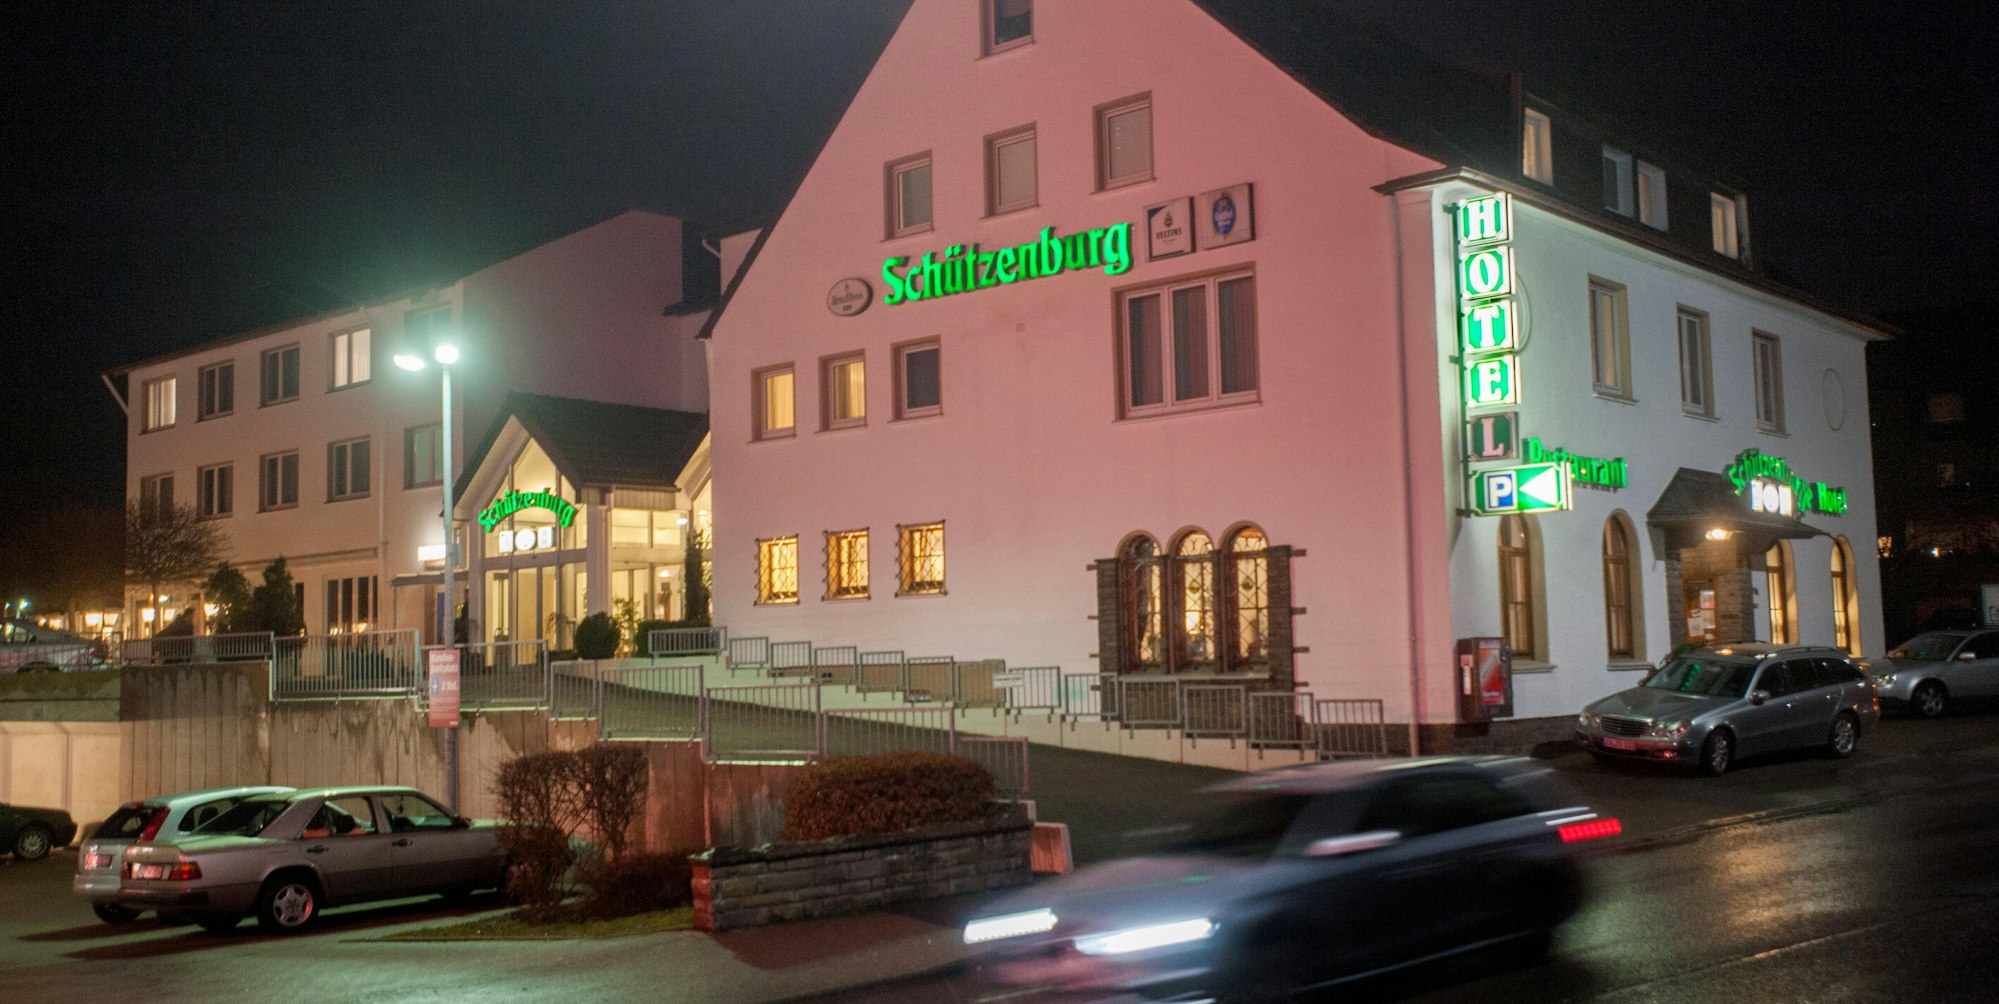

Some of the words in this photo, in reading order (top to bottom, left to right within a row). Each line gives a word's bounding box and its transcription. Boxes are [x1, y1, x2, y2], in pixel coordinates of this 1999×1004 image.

[882, 222, 1130, 304] Schützenburg
[1467, 197, 1504, 457] HOTEL
[478, 488, 575, 534] Schützenburg
[1488, 475, 1513, 507] P
